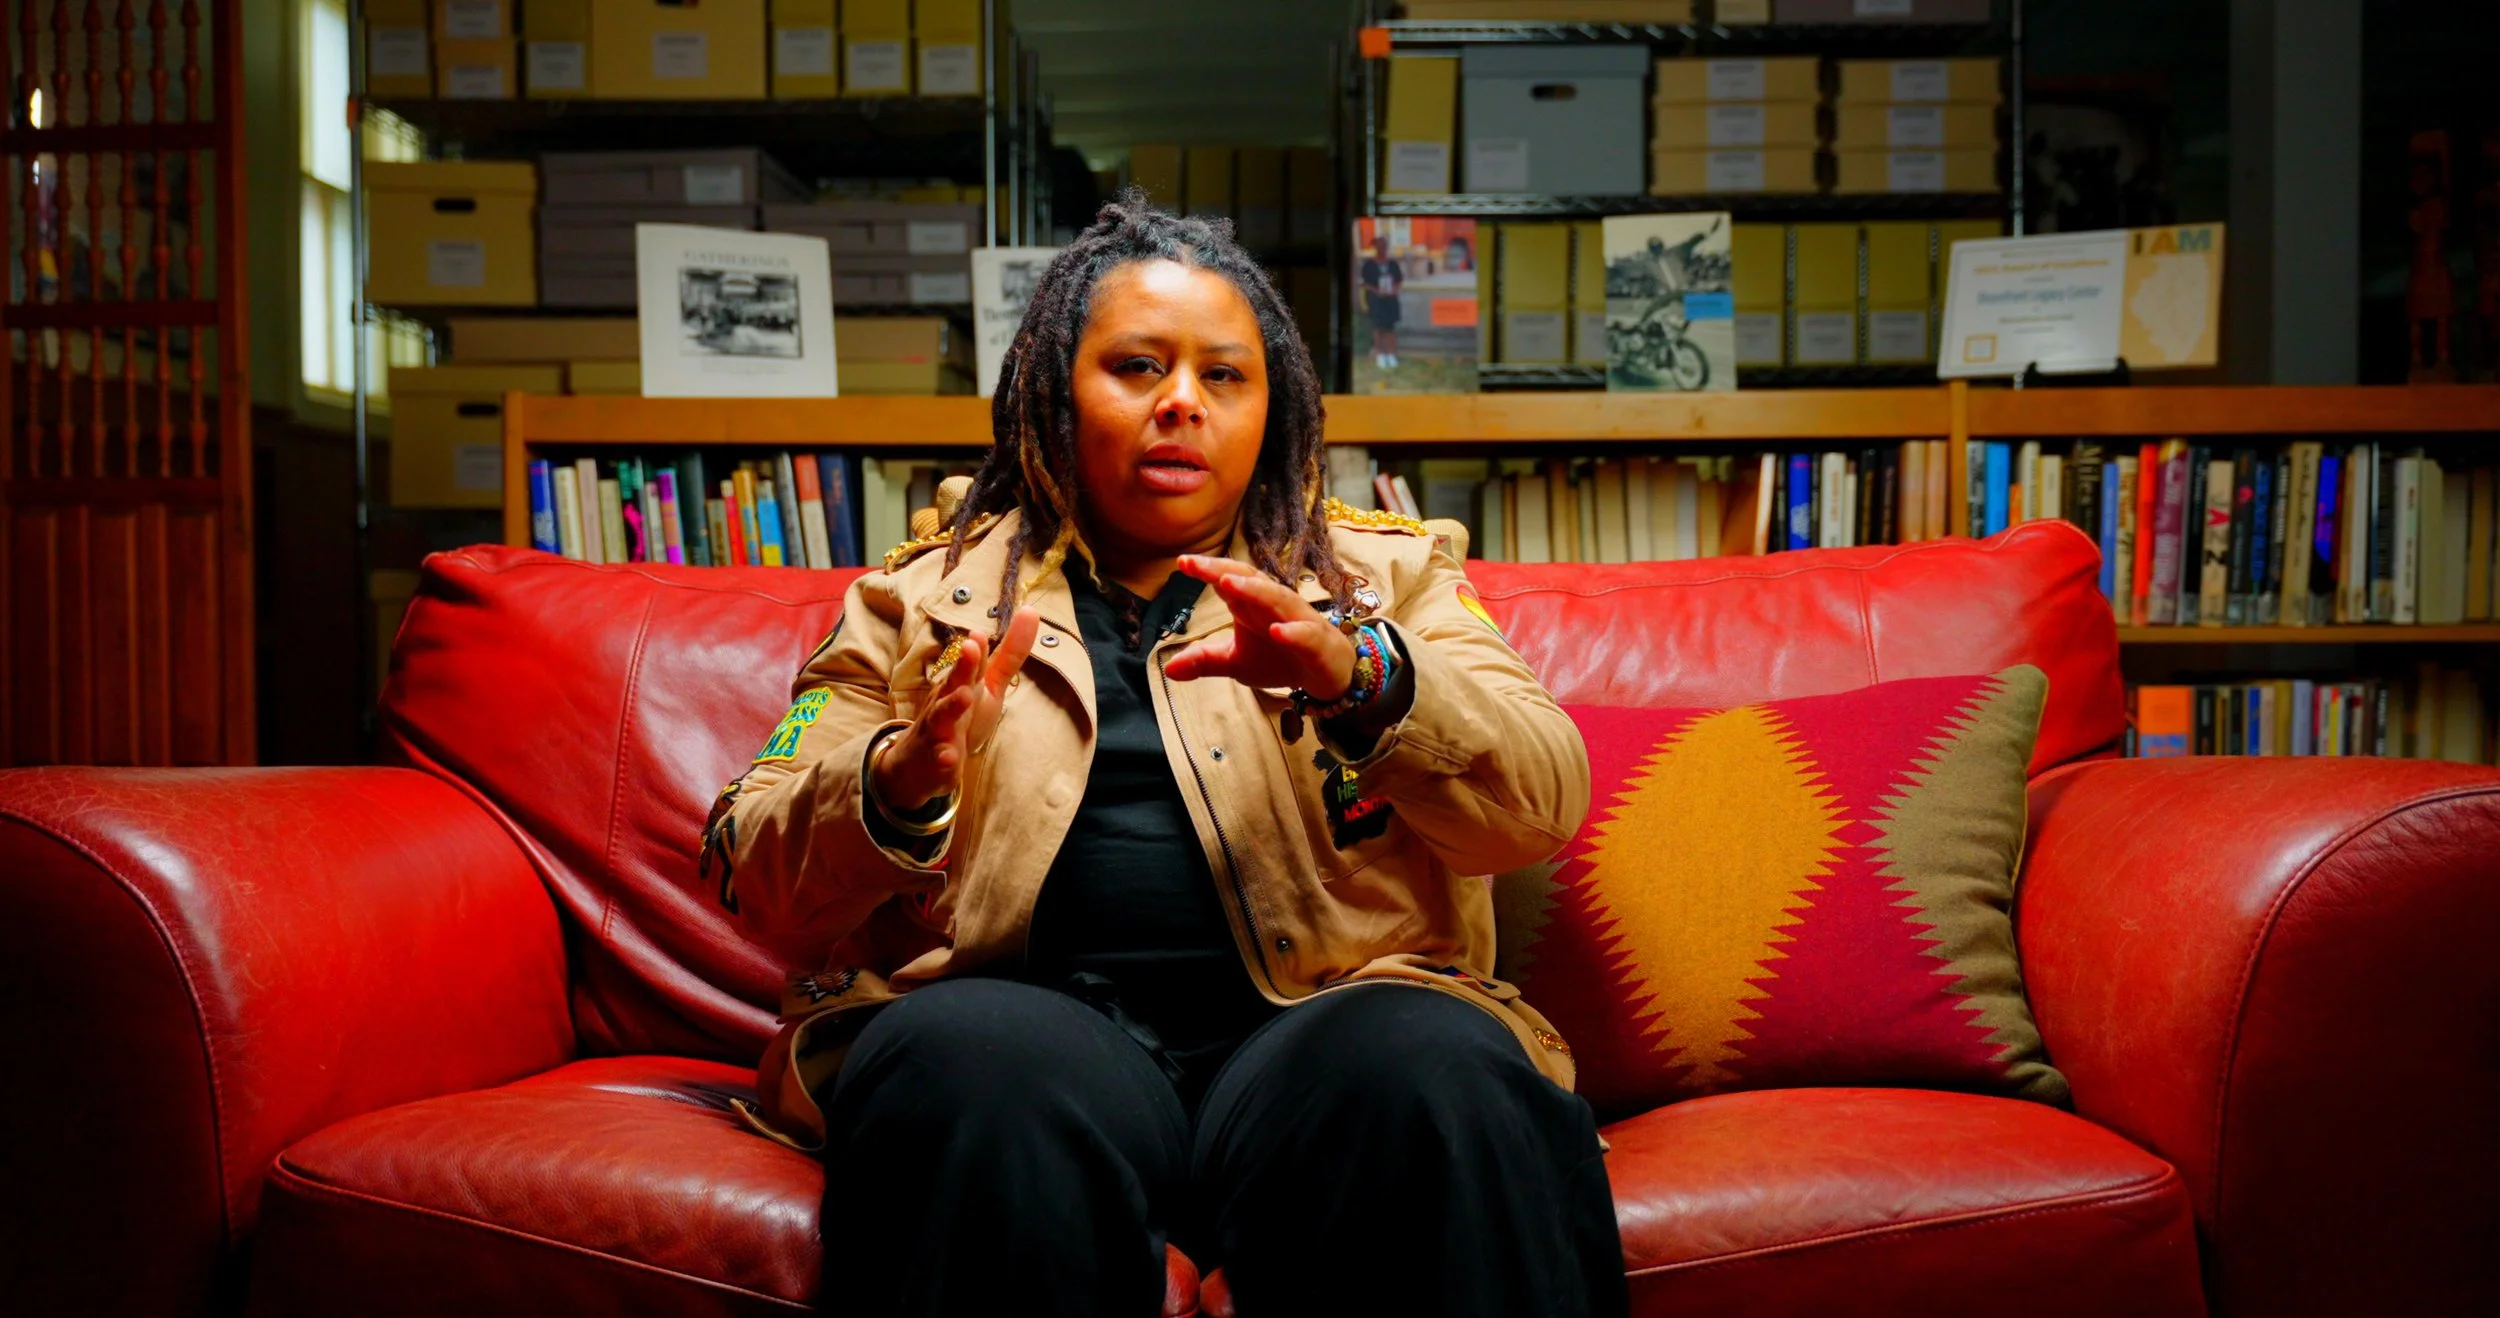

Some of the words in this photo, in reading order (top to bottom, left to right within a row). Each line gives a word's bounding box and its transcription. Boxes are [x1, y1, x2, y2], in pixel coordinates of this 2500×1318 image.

[2150, 228, 2213, 255] AM
[2204, 495, 2232, 566] JAZZ
[1341, 765, 1359, 782] B
[1336, 779, 1359, 803] HIS
